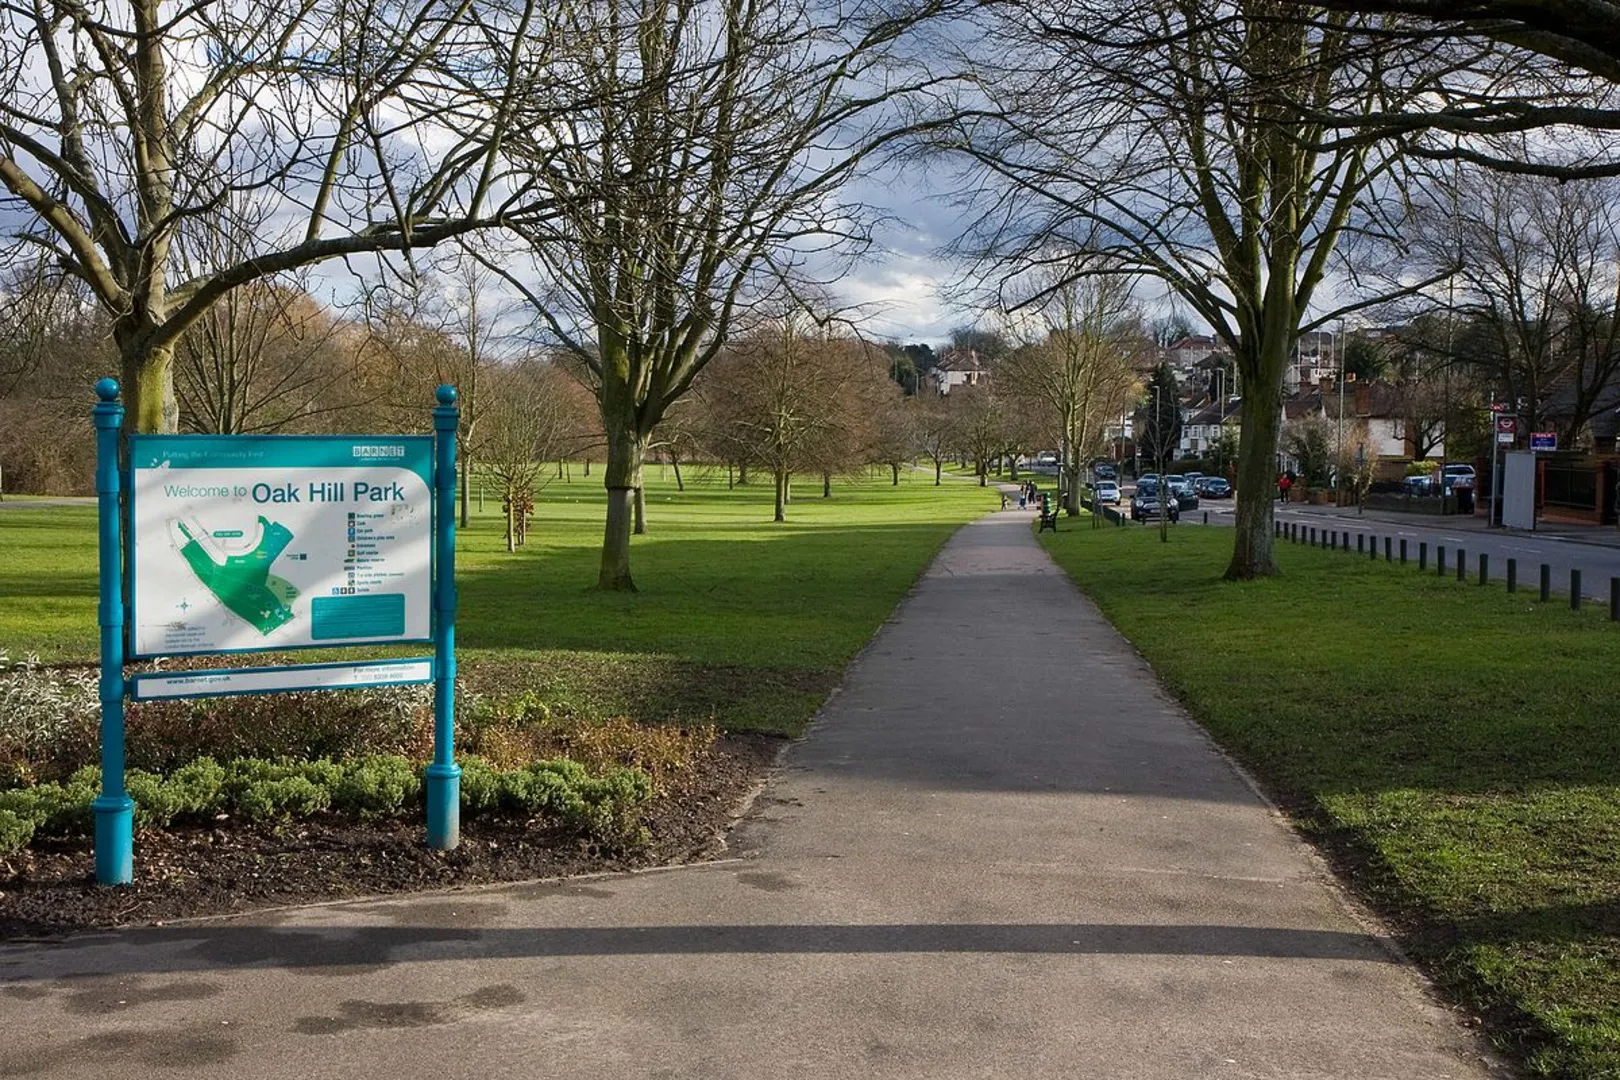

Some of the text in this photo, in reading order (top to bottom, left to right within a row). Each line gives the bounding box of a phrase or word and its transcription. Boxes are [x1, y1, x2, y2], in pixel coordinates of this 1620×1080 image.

[353, 446, 405, 457] BARNET
[164, 481, 405, 503] Welcome to Oak Hill Park
